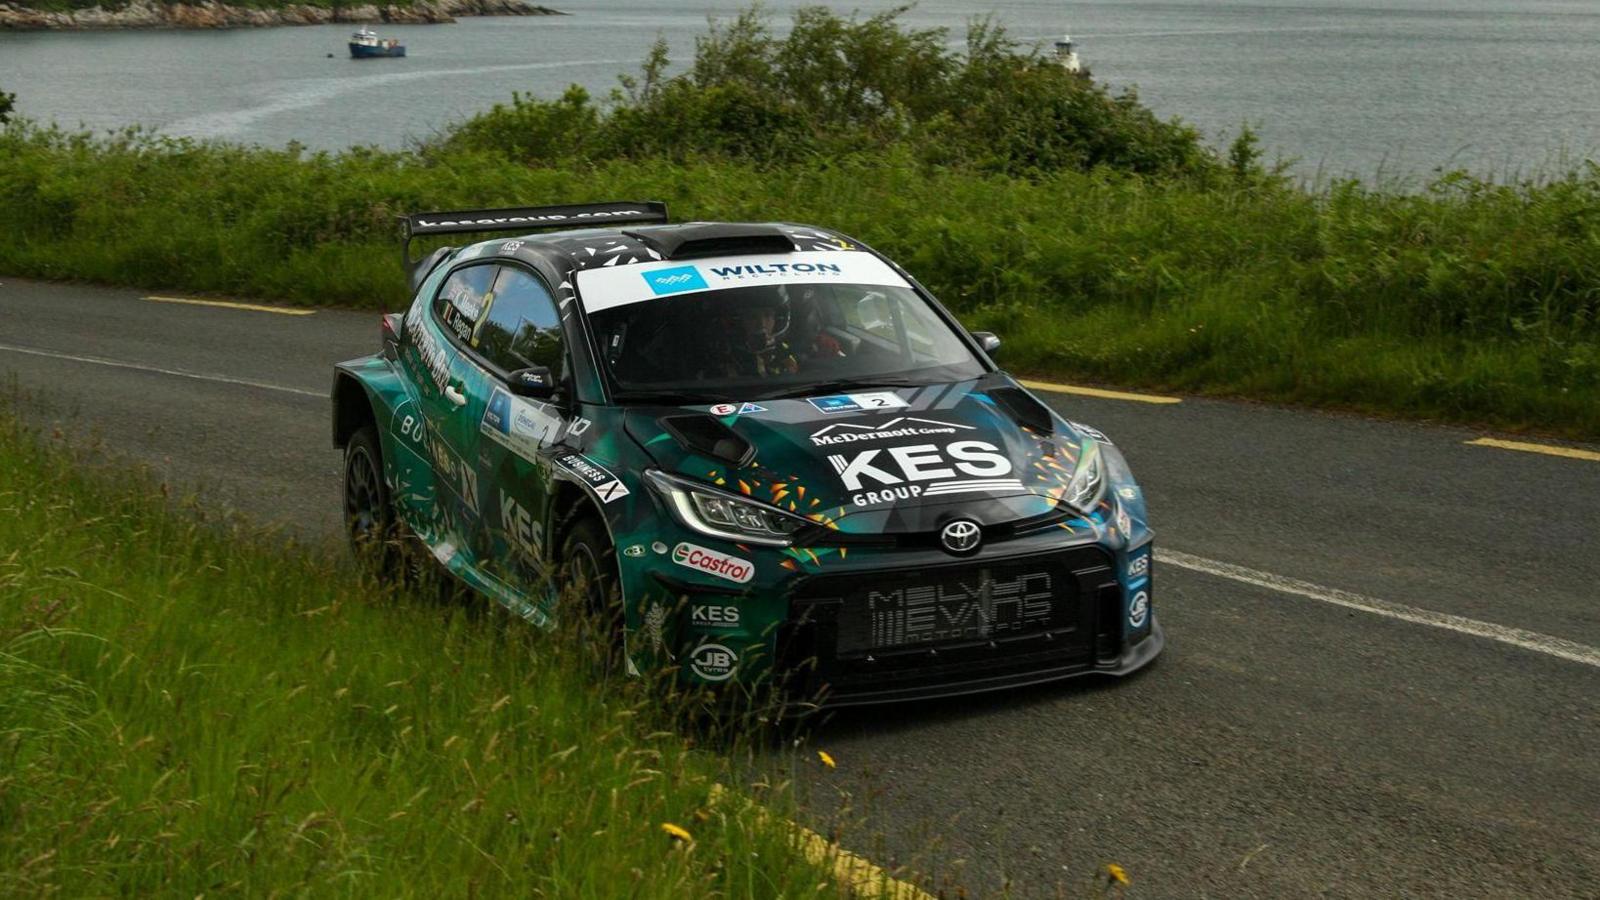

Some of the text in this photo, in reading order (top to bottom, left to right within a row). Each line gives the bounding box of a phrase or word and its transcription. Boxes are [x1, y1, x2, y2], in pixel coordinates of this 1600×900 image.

[710, 263, 841, 277] WILTON
[453, 312, 472, 341] Regan
[872, 398, 890, 407] 2
[812, 426, 956, 447] McDermott Group
[562, 455, 606, 482] BUSINESS
[828, 440, 1012, 491] KES
[853, 485, 922, 507] GROUP
[688, 550, 750, 580] Castrol
[692, 605, 740, 622] KES
[694, 652, 730, 667] JB
